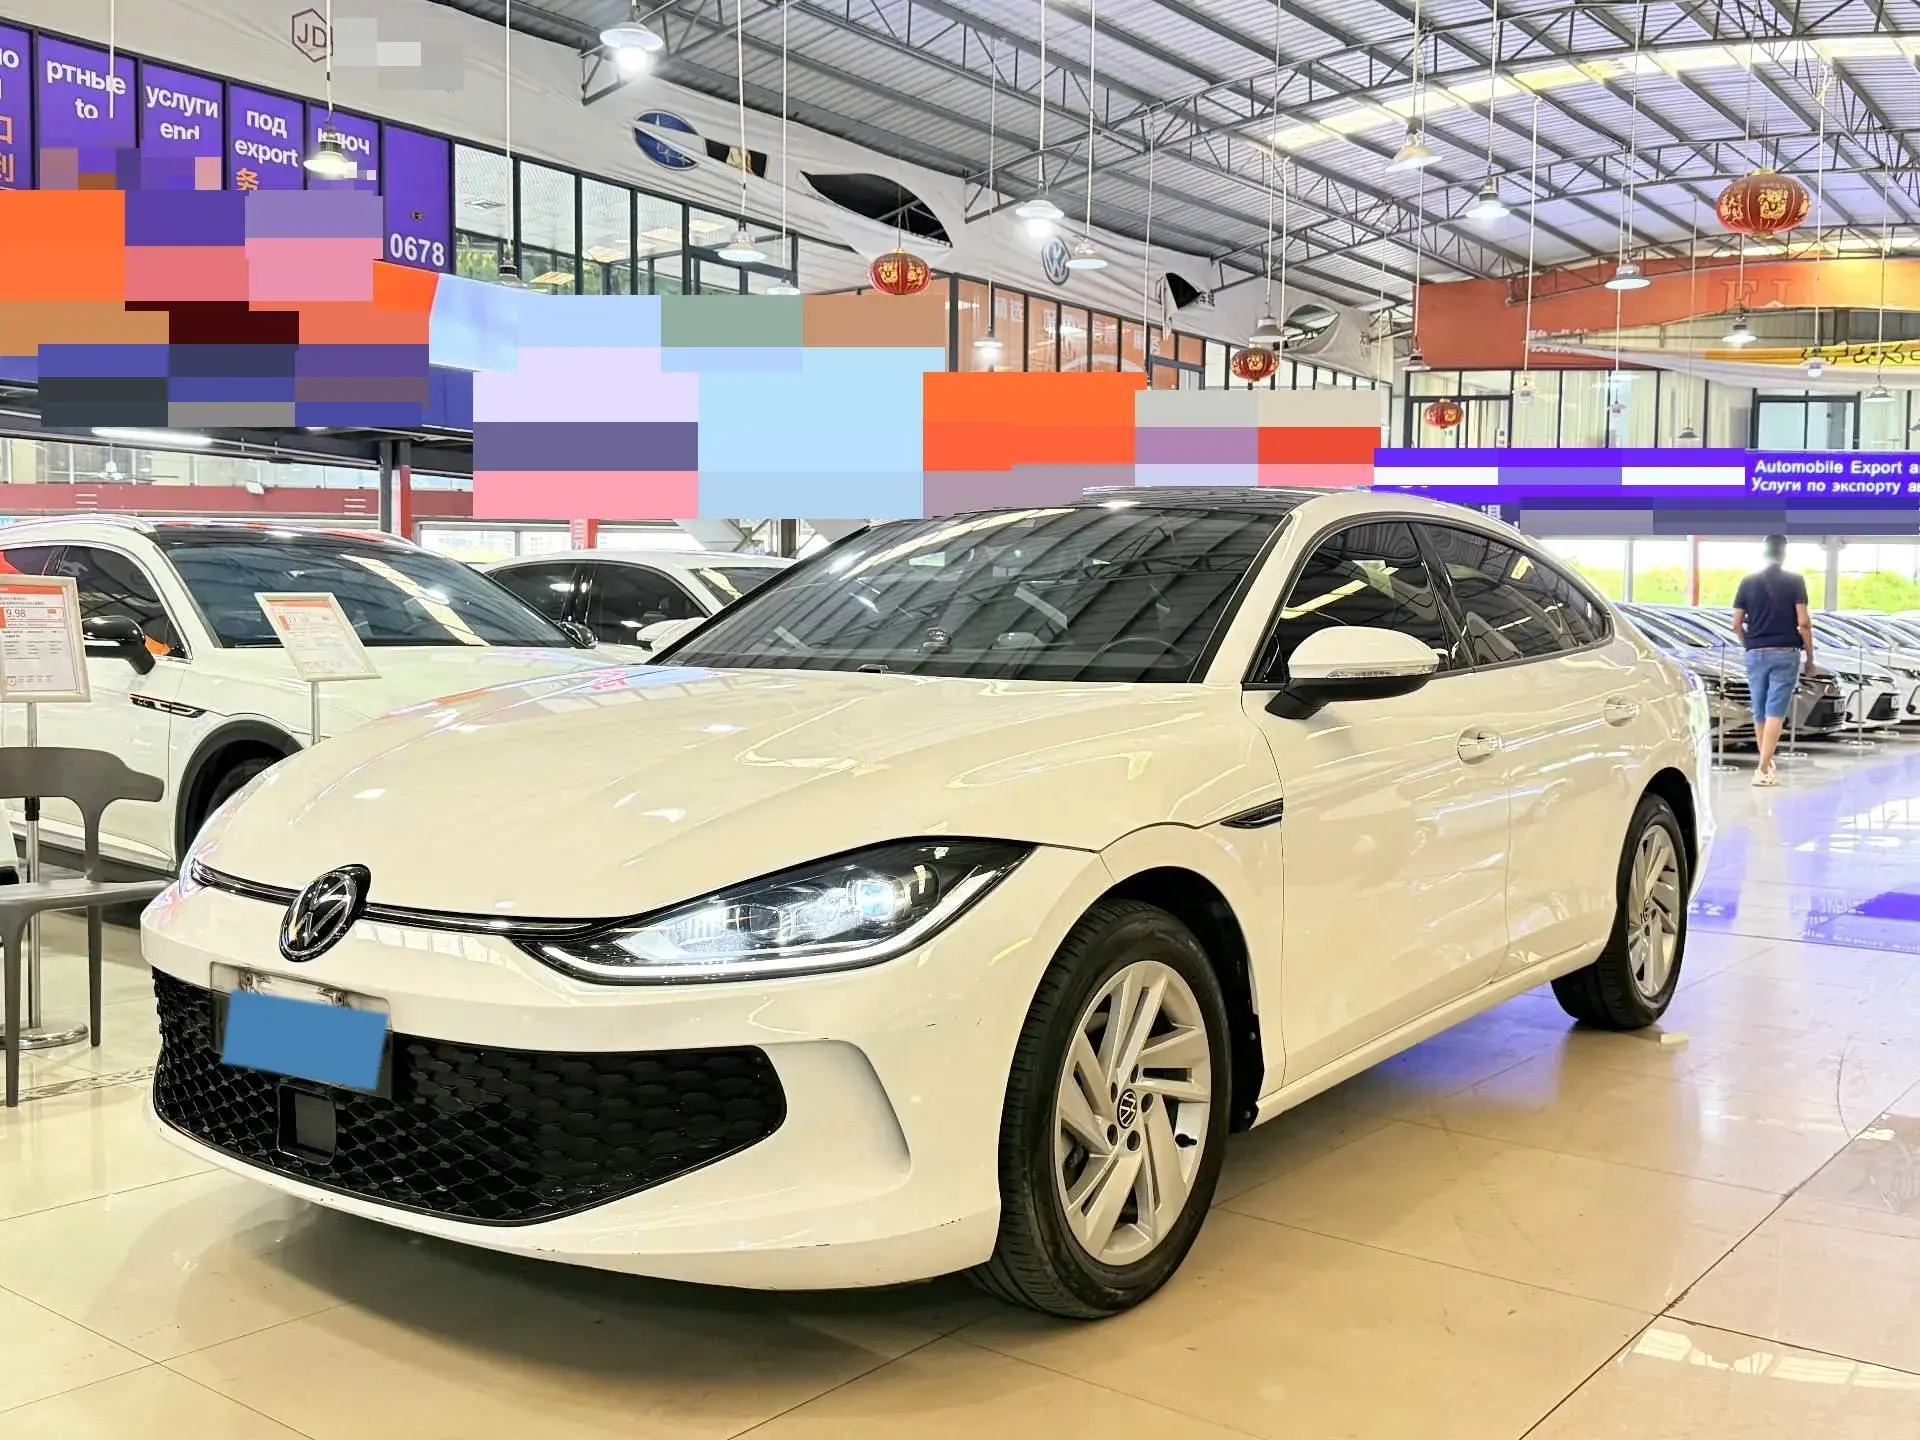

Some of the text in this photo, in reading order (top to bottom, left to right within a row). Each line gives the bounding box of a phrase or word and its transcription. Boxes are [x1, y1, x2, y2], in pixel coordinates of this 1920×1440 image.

[145, 85, 219, 118] услуги
[246, 110, 287, 139] под
[75, 98, 99, 119] to
[235, 139, 299, 167] export
[390, 232, 445, 267] 0678
[1755, 459, 1920, 477] Automobile Export a
[1752, 477, 1801, 495] Услуги
[1807, 481, 1826, 492] по
[1832, 481, 1901, 495] экспорту
